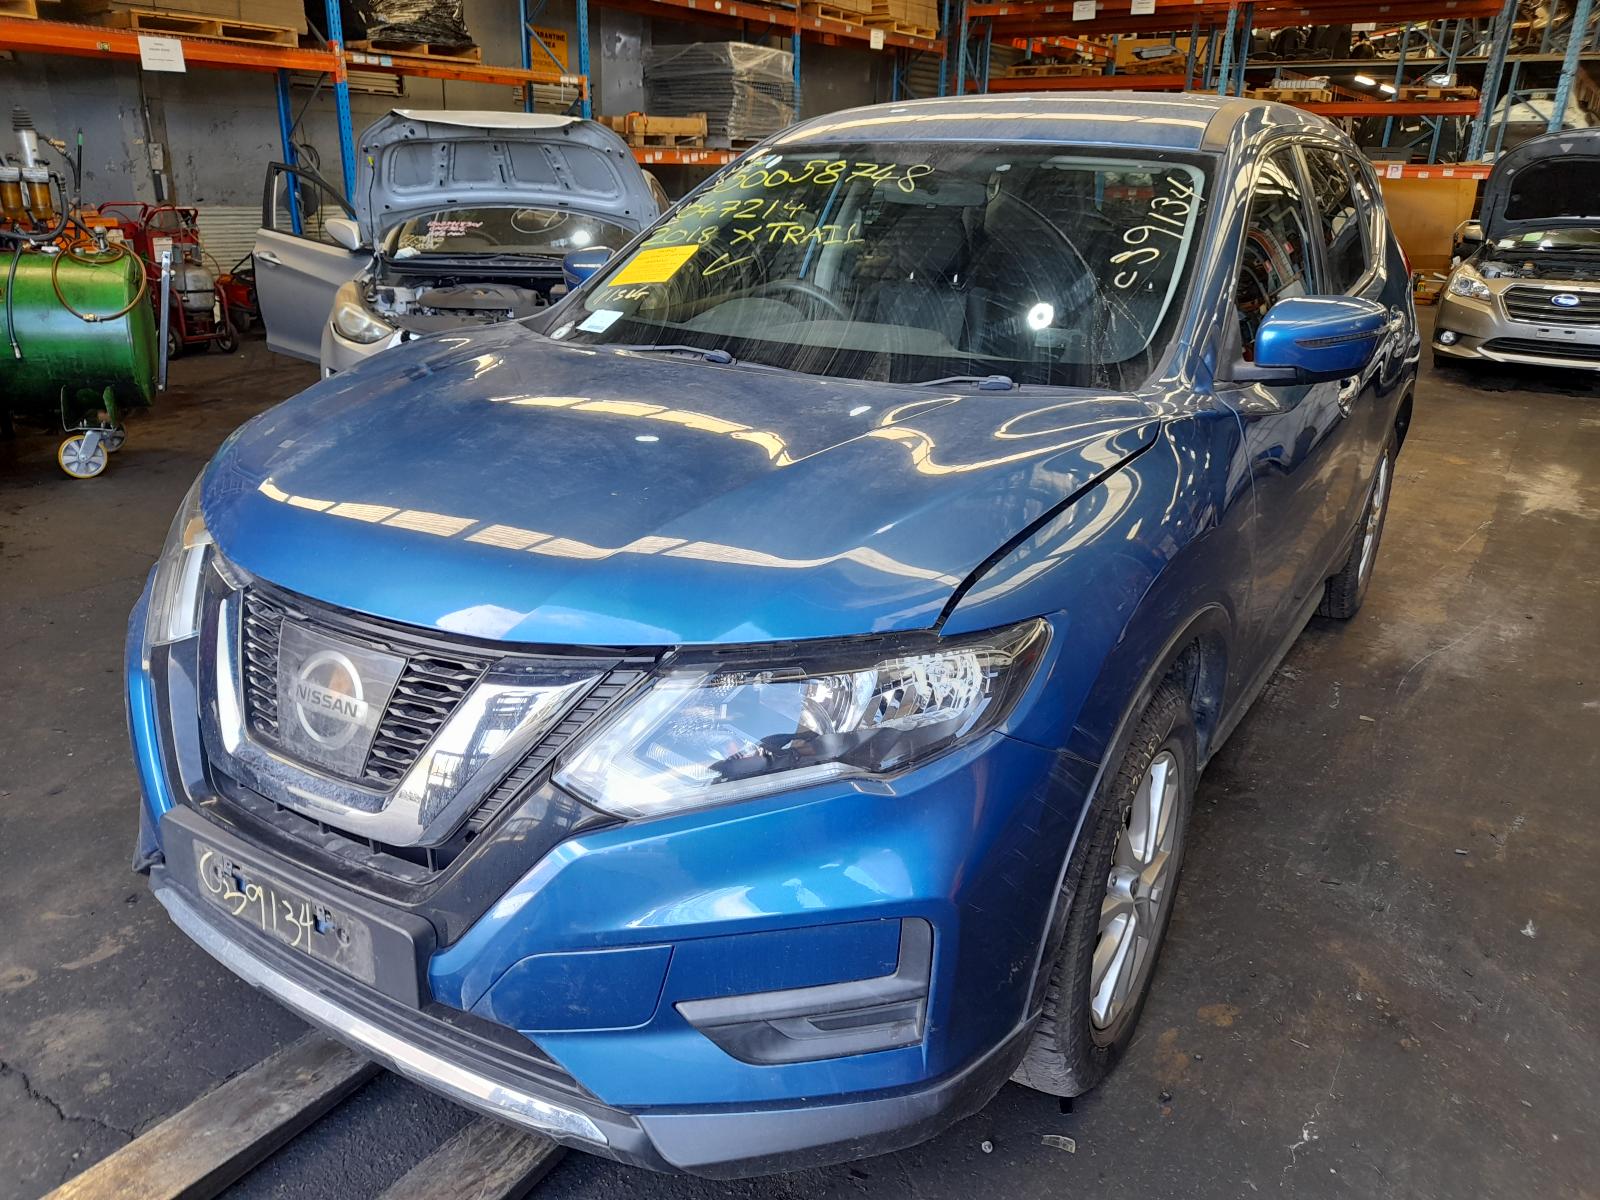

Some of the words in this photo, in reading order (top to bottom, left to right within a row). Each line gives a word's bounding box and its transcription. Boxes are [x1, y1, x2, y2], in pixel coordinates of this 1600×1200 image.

[640, 225, 719, 244] 2018
[1109, 176, 1206, 289] C39134
[296, 684, 358, 719] NISSAN
